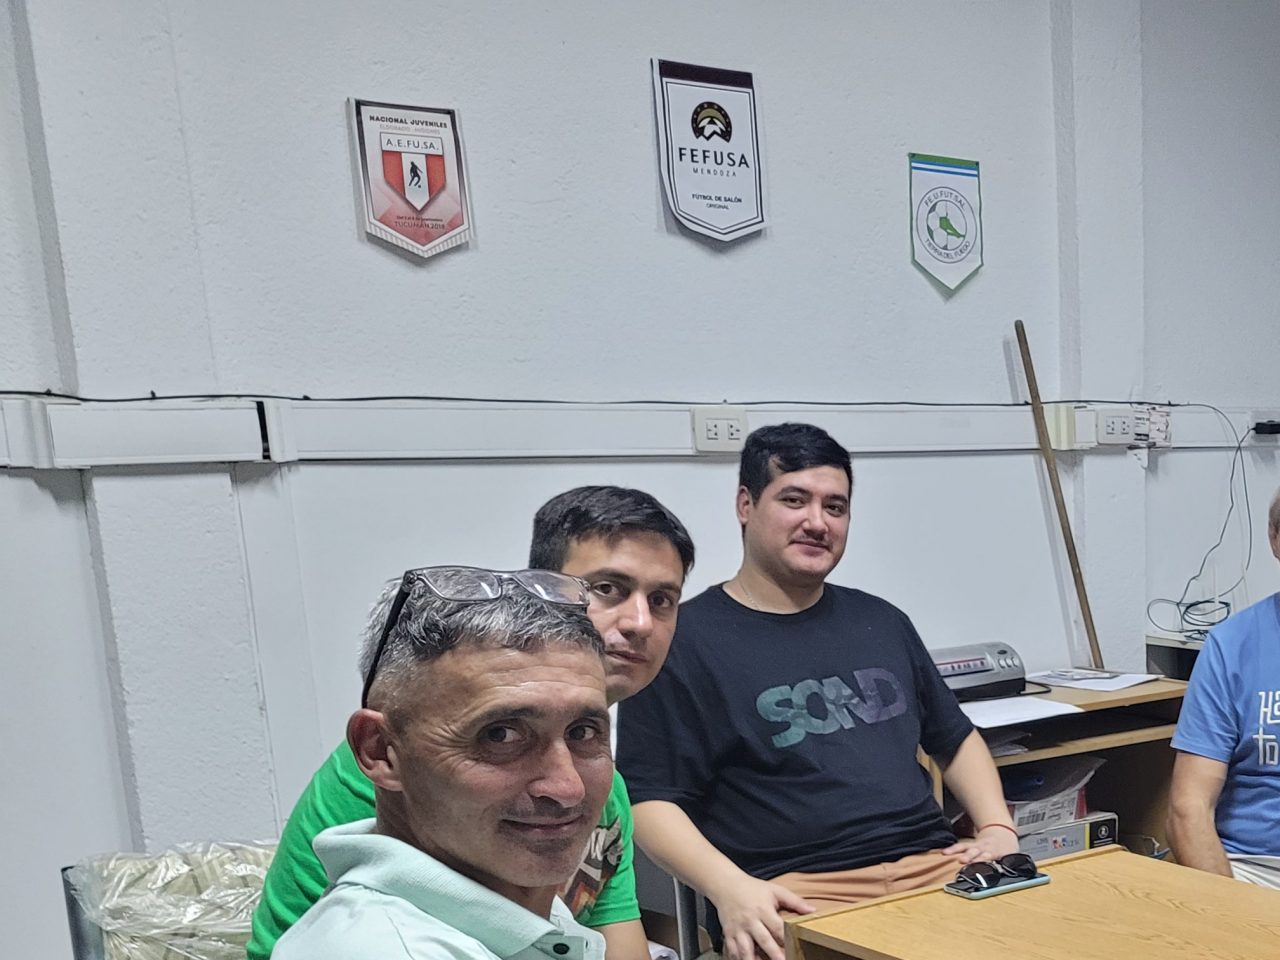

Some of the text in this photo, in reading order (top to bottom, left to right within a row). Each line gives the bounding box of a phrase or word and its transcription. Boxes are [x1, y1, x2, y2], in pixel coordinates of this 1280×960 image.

[369, 115, 448, 129] NACIONAL JUVENILES
[678, 147, 750, 168] FEFUSA
[692, 167, 737, 177] MENDOZA
[1252, 727, 1279, 766] to
